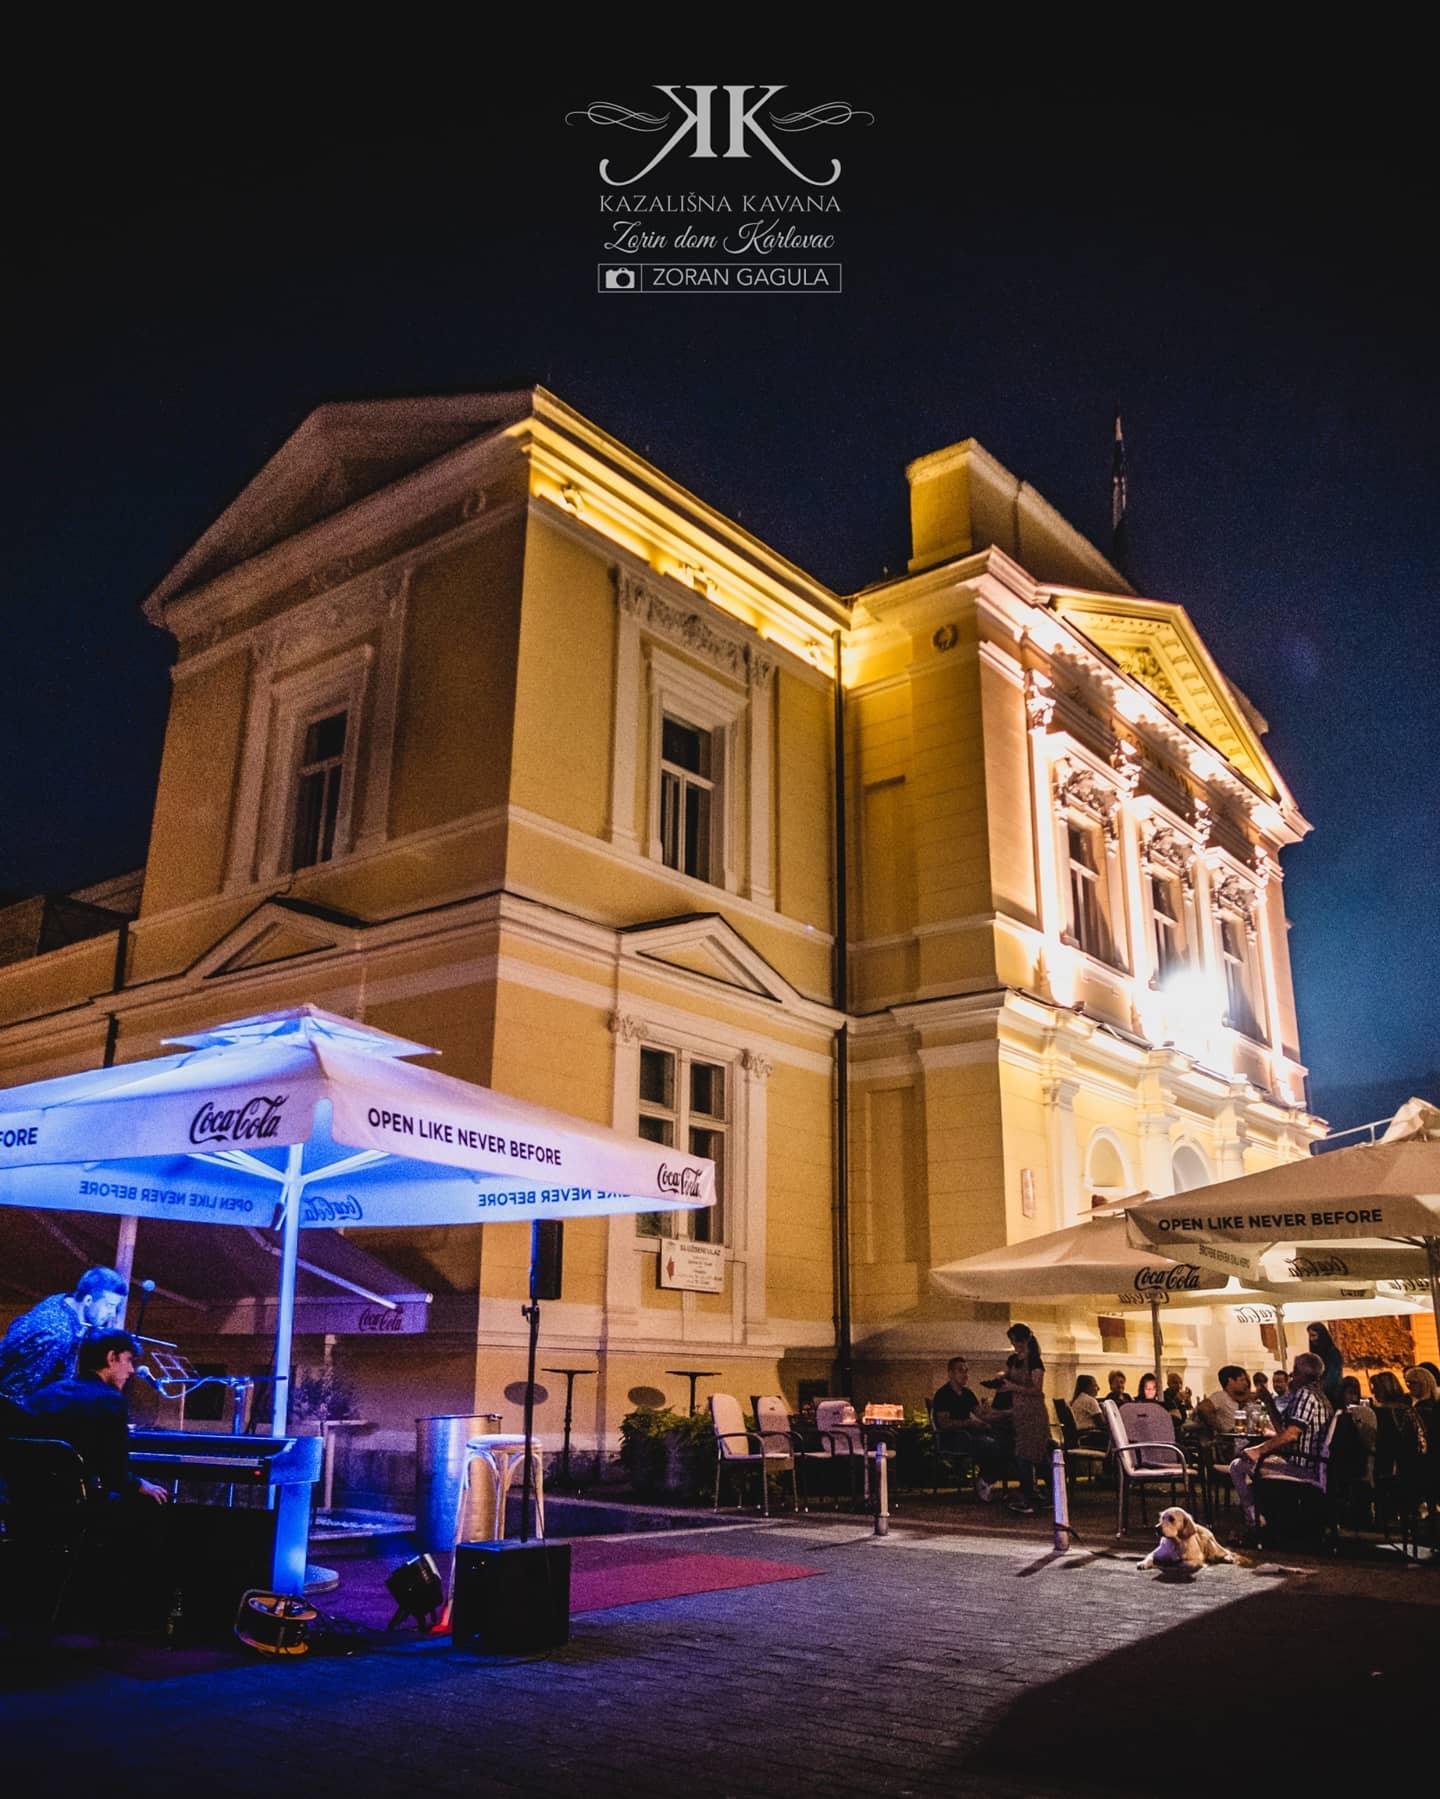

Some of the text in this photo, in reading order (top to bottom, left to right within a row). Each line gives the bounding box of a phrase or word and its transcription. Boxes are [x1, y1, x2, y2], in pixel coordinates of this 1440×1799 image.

[189, 1095, 290, 1145] Coca-Cola
[368, 1108, 562, 1165] OPEN LIKE NEVER BEFORE
[1158, 1209, 1382, 1232] OPEN LIKE NEVER BEFORE
[1134, 1264, 1201, 1291] Coca-Cola
